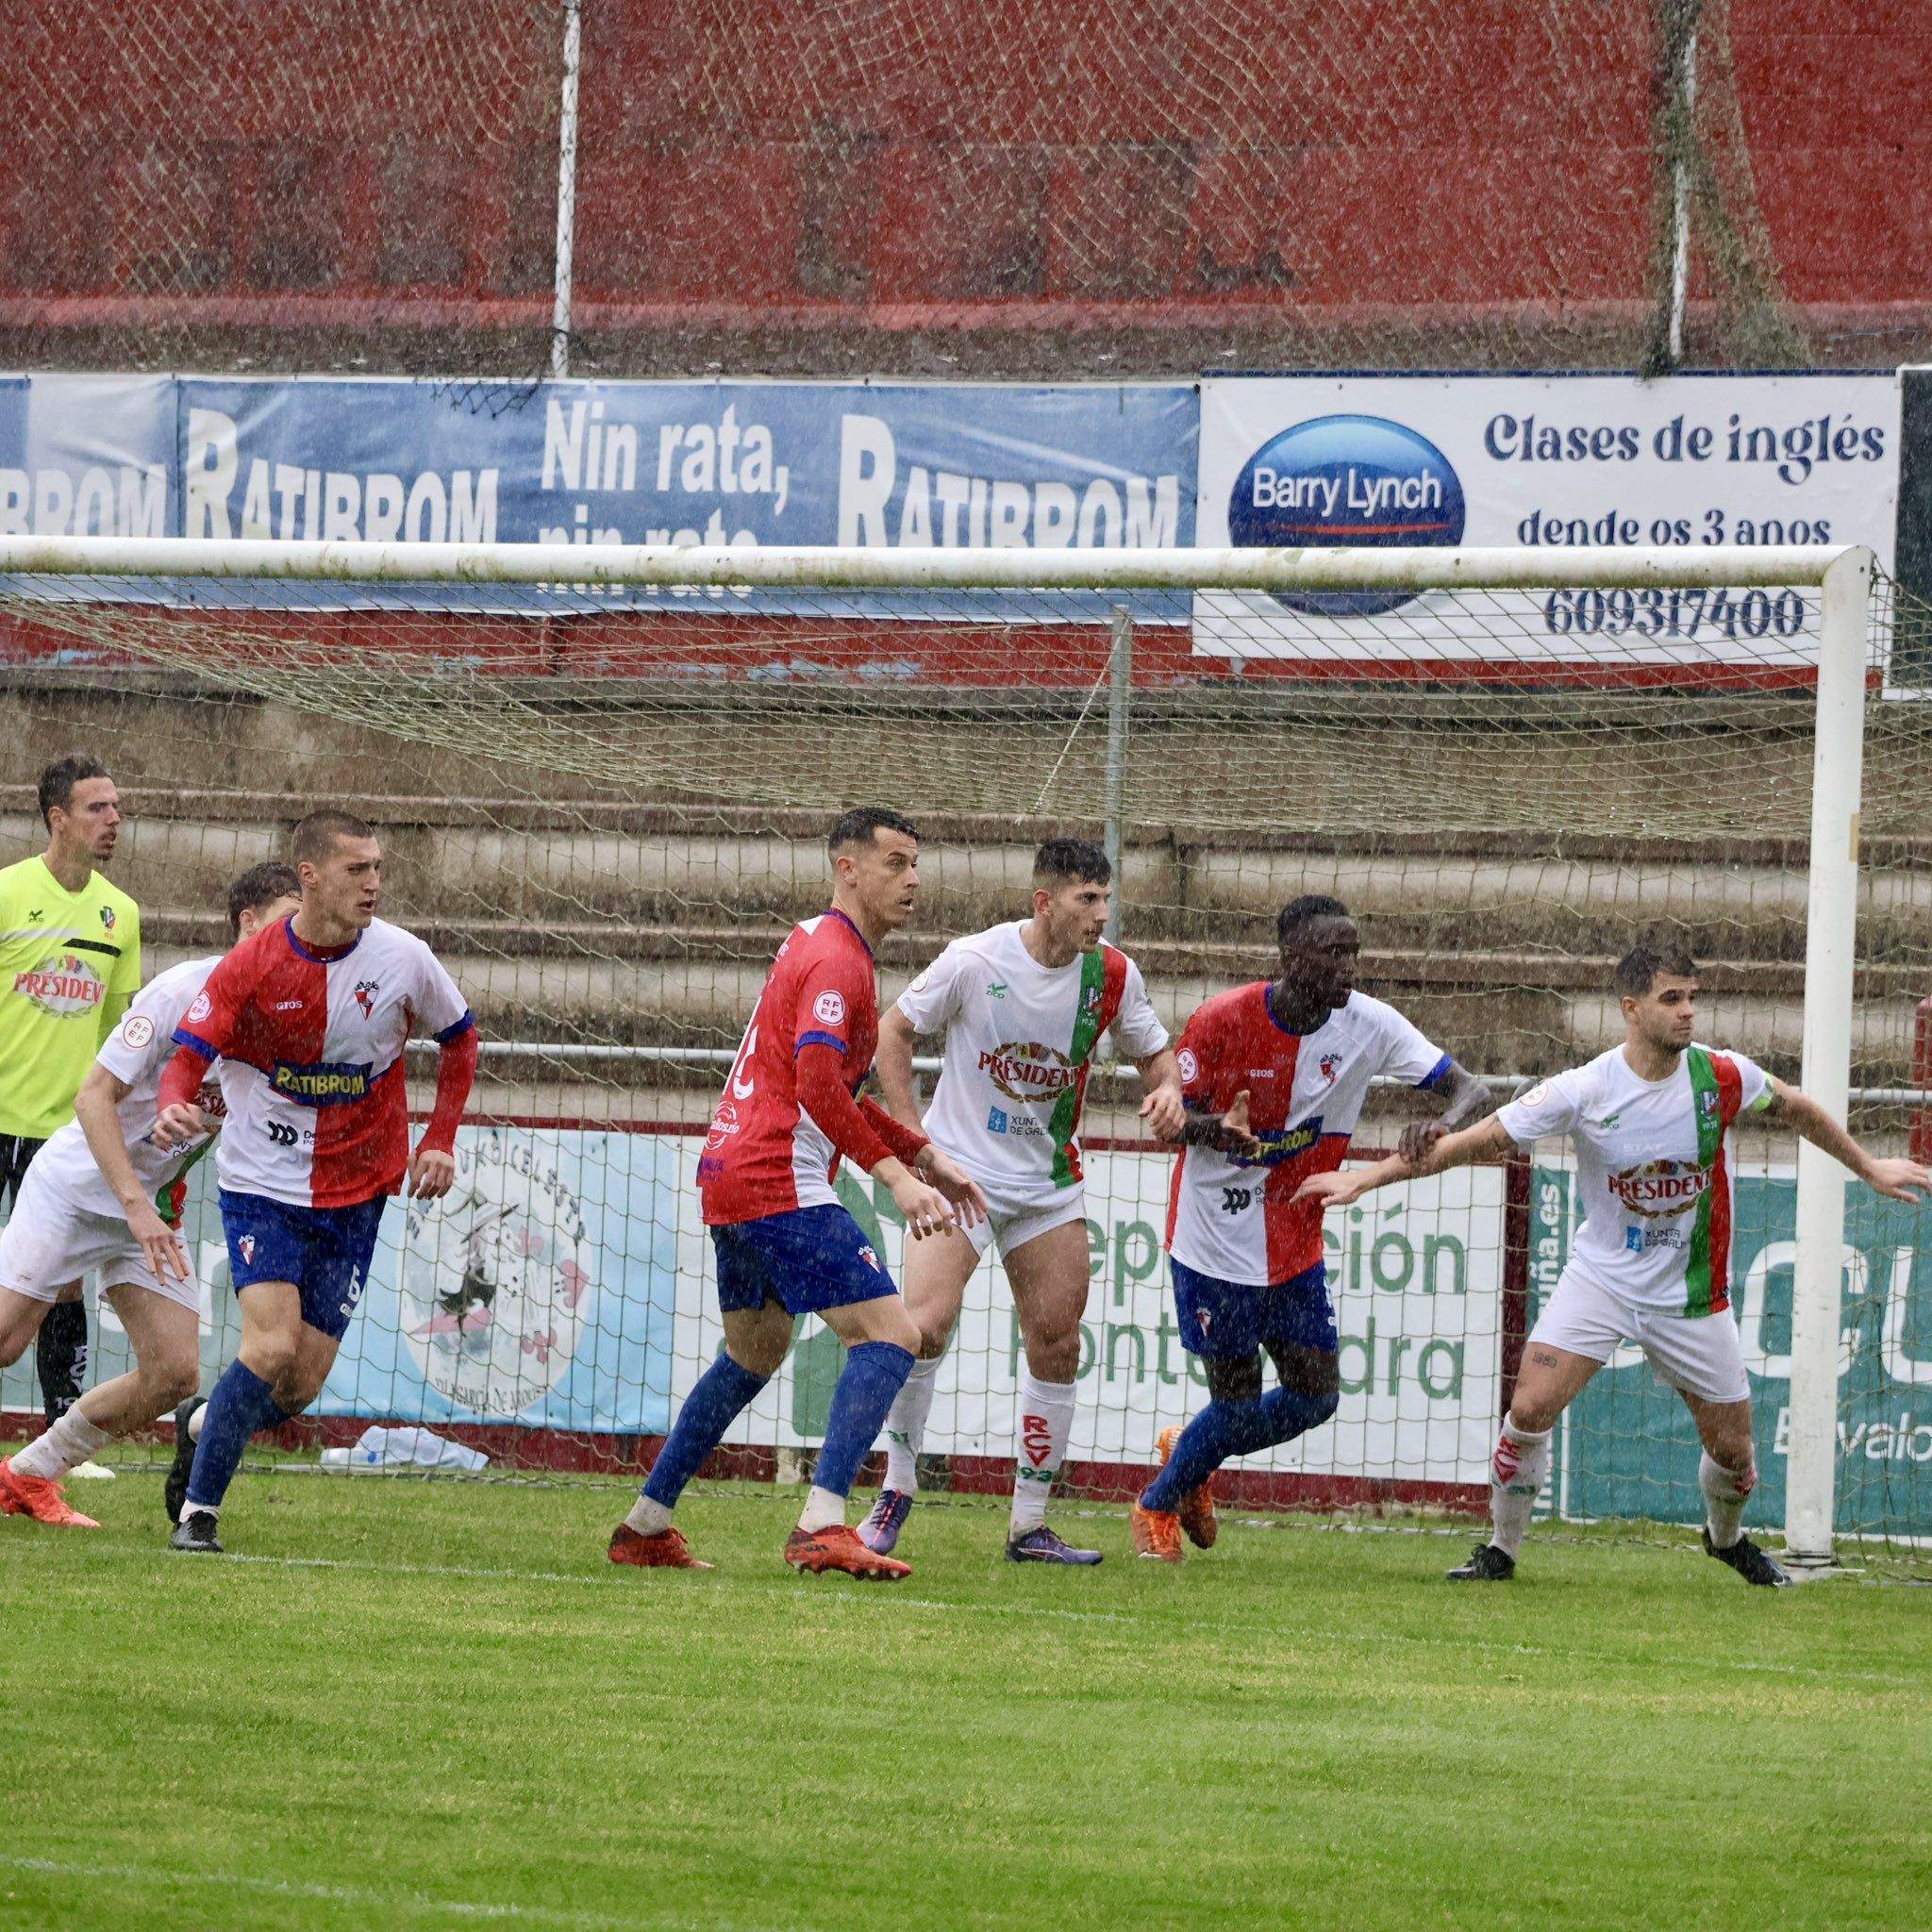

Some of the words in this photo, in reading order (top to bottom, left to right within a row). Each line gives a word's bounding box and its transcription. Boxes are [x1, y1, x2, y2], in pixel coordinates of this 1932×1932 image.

[541, 400, 639, 491] Nin
[656, 403, 790, 517] rata,
[1484, 413, 1641, 462] Clases
[1653, 414, 1713, 462] de
[1727, 412, 1886, 487] inglés
[1253, 467, 1341, 518] Barry
[1346, 468, 1442, 518] Lynch
[1517, 509, 1641, 546] dende
[1651, 518, 1691, 546] os
[1702, 508, 1724, 546] 3
[1734, 519, 1832, 546] anos
[1544, 589, 1805, 638] 609317400
[275, 1066, 365, 1095] RATIBROM
